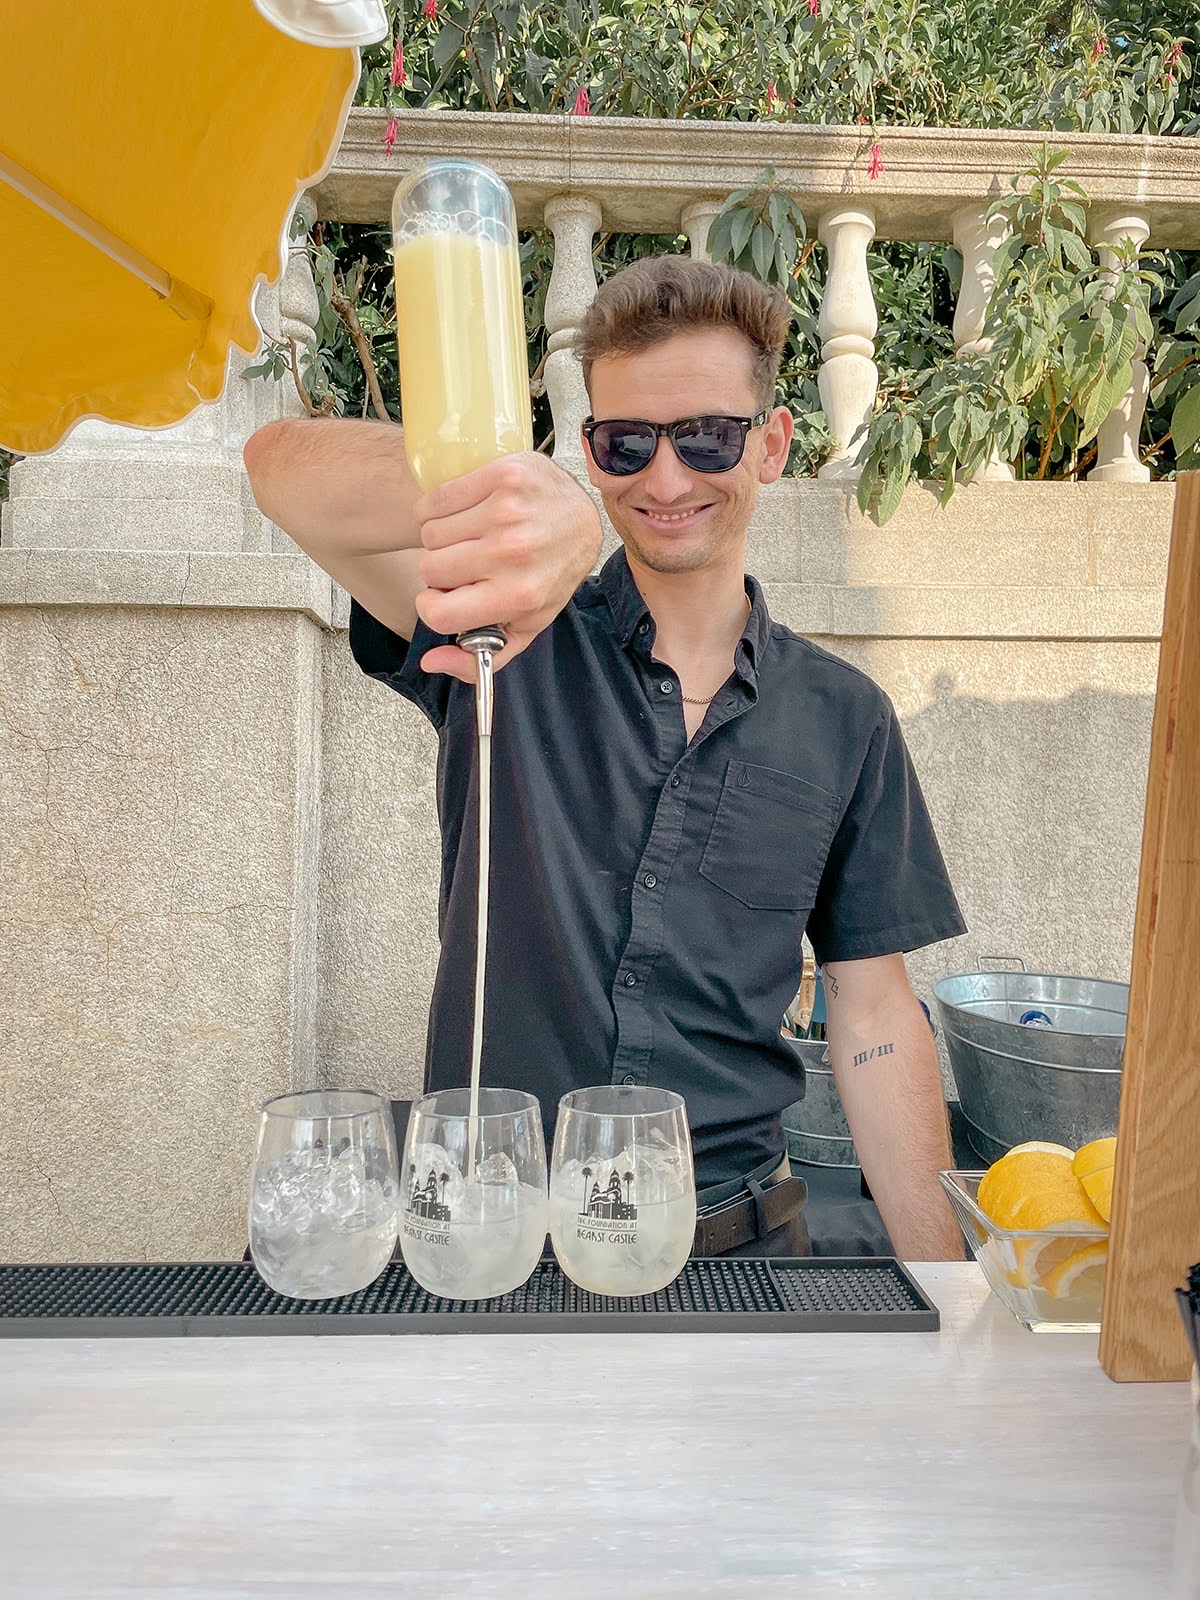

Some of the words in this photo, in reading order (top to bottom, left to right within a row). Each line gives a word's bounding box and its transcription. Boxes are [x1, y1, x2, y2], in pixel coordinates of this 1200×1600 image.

[588, 1219, 628, 1229] FOUNDATION
[424, 1232, 450, 1246] CASTLE
[608, 1233, 637, 1244] CASTLE
